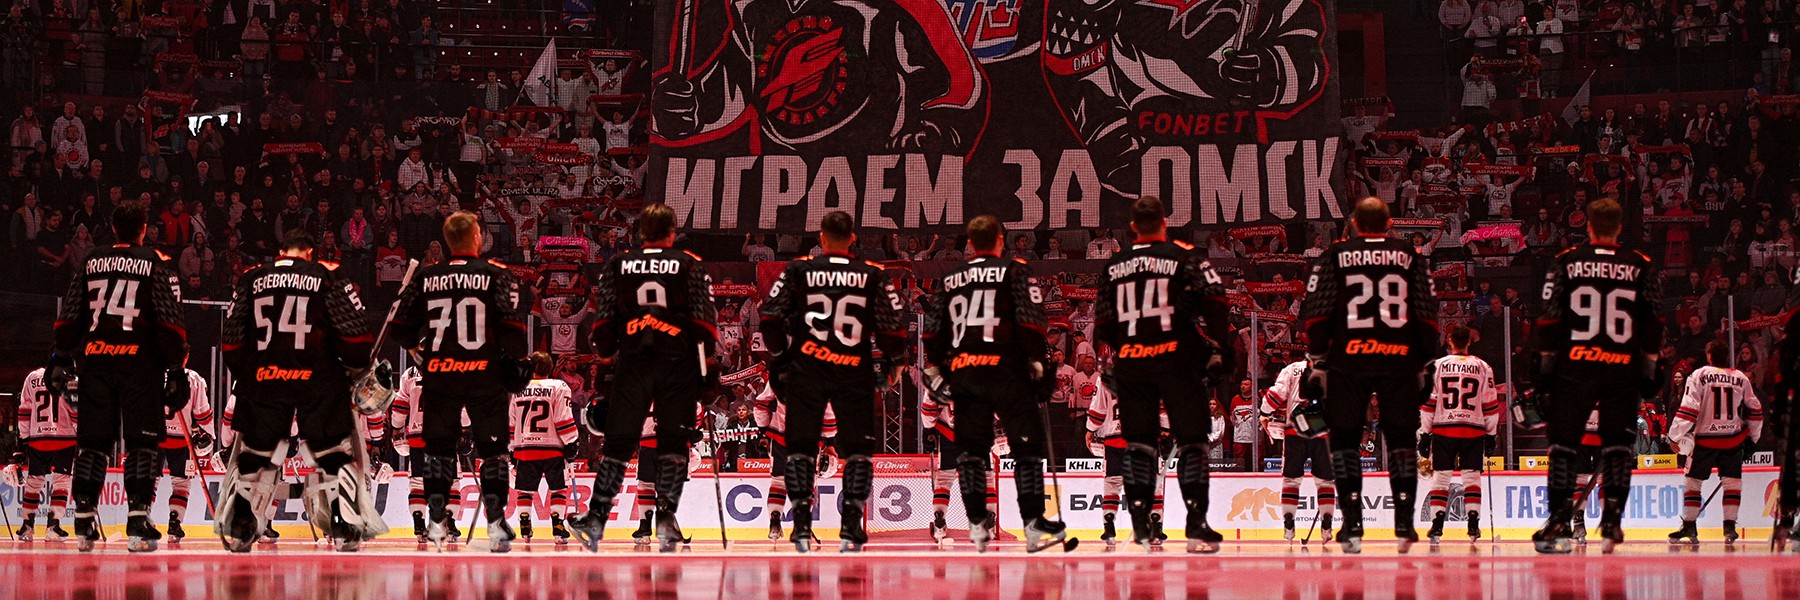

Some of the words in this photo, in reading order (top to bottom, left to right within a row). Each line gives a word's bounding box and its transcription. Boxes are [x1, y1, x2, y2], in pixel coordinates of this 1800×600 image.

[1138, 110, 1251, 136] FONBET
[664, 153, 965, 232] ИГРАЕМ
[1001, 148, 1101, 229] ЗА
[1139, 136, 1345, 228] ОМСК
[86, 256, 152, 276] PROKHORKIN
[621, 259, 680, 275] MCLEOD
[1338, 250, 1412, 270] IBRAGIMOV
[253, 273, 322, 294] SEREBRYAKOV
[423, 273, 490, 293] MARTYNOV
[806, 271, 868, 288] VOYNOV
[88, 279, 140, 332] 74
[1117, 278, 1175, 337] 44
[1345, 274, 1408, 329] 28
[254, 295, 312, 351] 54
[427, 297, 486, 352] 70
[805, 293, 867, 347] 26
[949, 289, 1001, 349] 84
[1570, 286, 1637, 344] 96
[801, 340, 861, 366] G-DRIVE
[1119, 341, 1178, 358] G-DRIVE
[1345, 339, 1409, 355] G-DRIVE
[1569, 346, 1631, 365] G-DRIVE
[427, 358, 488, 373] G-DRIVE
[1441, 364, 1480, 375] MITYAKIN
[35, 390, 59, 423] 21
[1441, 376, 1479, 411] 52
[1711, 386, 1734, 420] 11
[516, 400, 550, 433] 72
[1068, 461, 1102, 470] KHL.R
